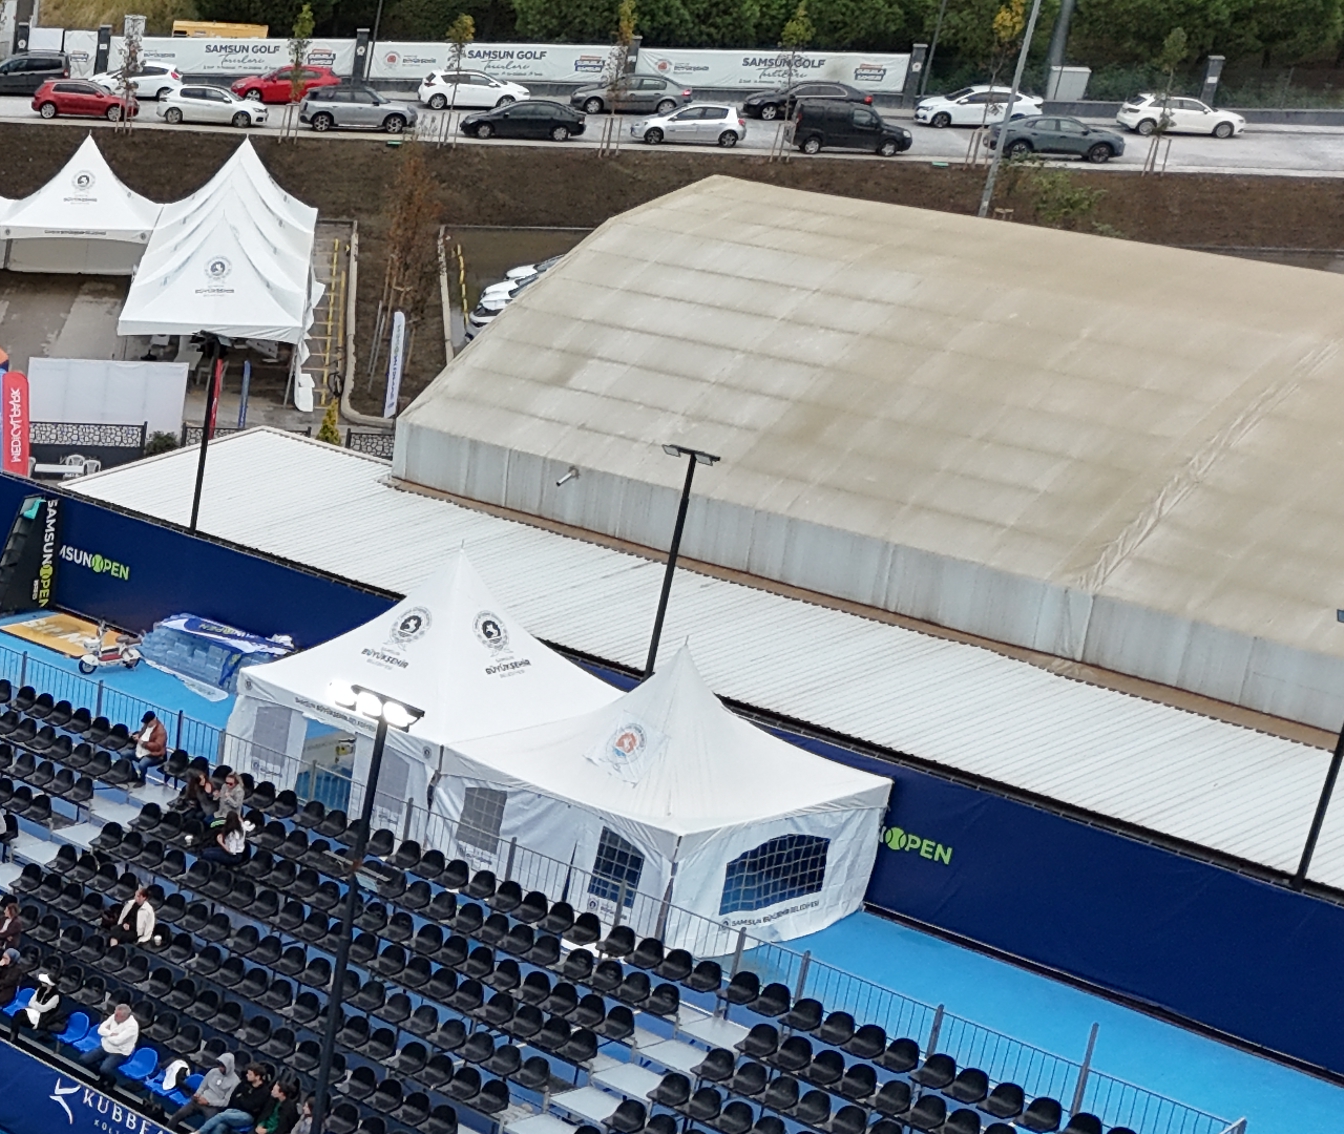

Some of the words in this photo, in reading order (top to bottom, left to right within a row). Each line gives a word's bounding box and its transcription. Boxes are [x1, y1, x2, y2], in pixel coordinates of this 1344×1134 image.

[205, 44, 250, 54] SAMSUN
[252, 45, 280, 55] GOLF
[467, 50, 514, 60] SAMSUN
[516, 51, 547, 61] GOLF
